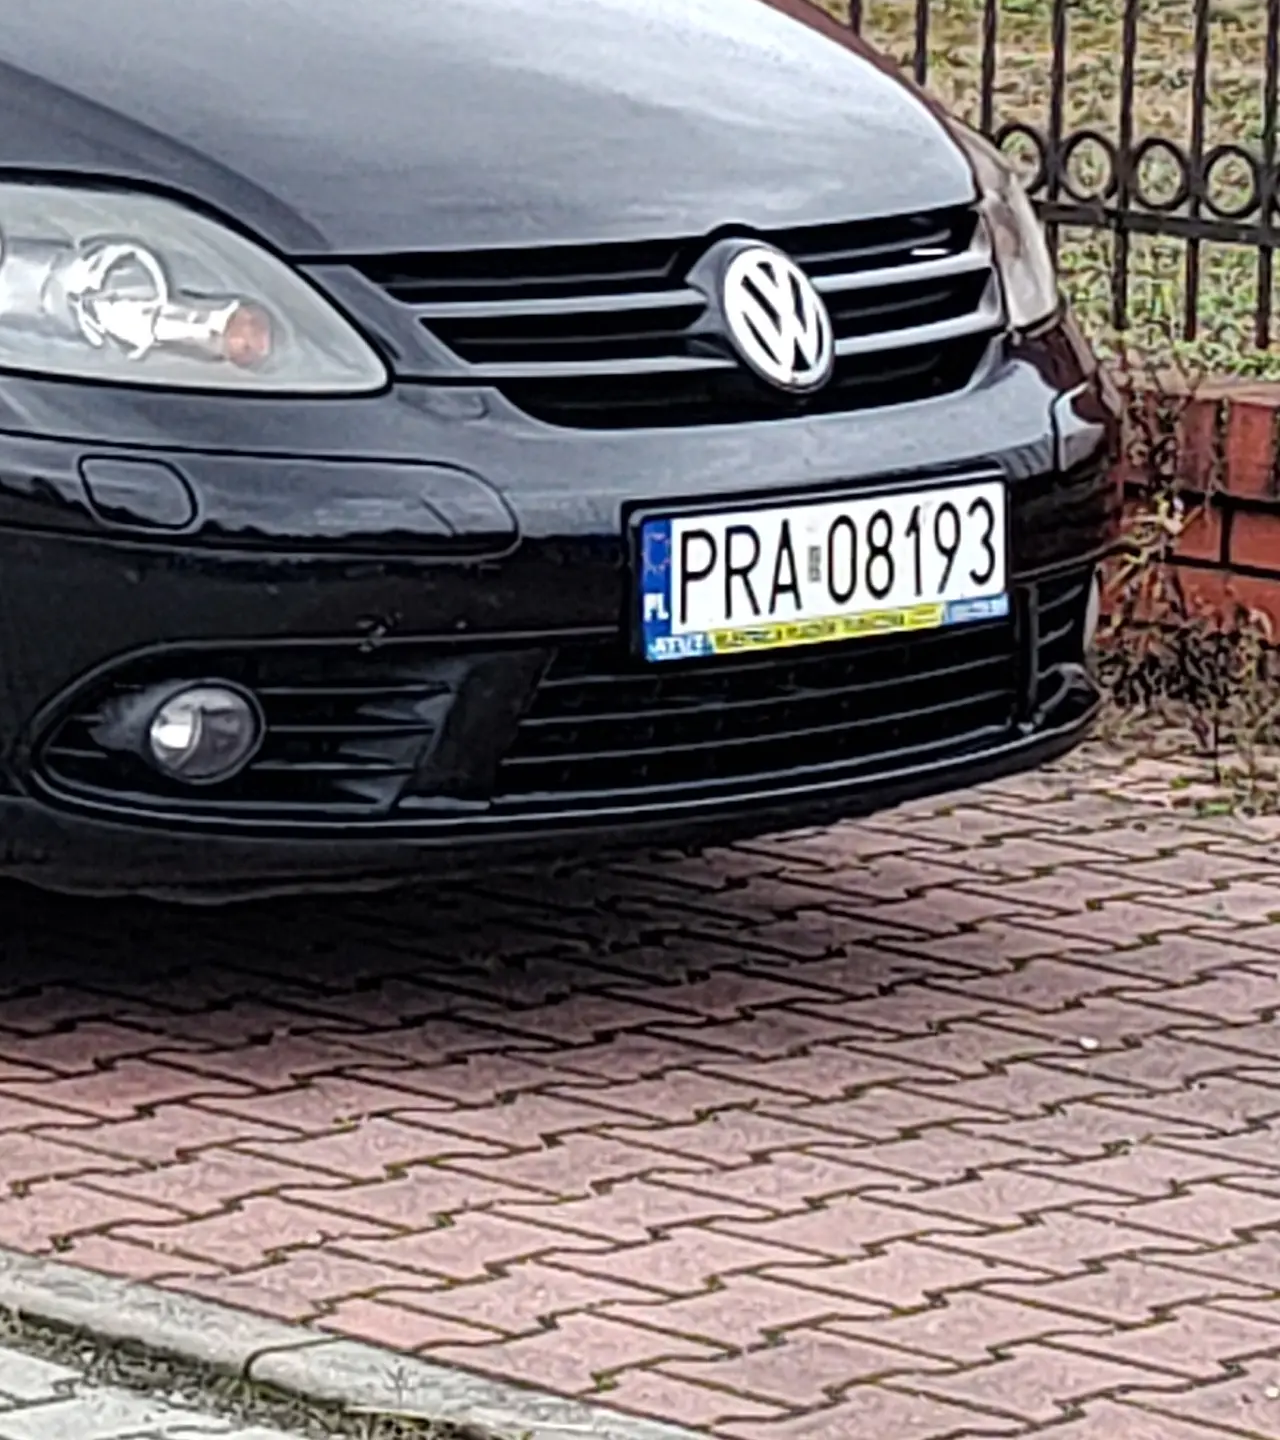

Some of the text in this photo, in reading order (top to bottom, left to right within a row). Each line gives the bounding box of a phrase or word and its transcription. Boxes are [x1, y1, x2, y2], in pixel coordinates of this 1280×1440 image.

[679, 496, 996, 625] PRA 08193
[643, 592, 669, 622] PL
